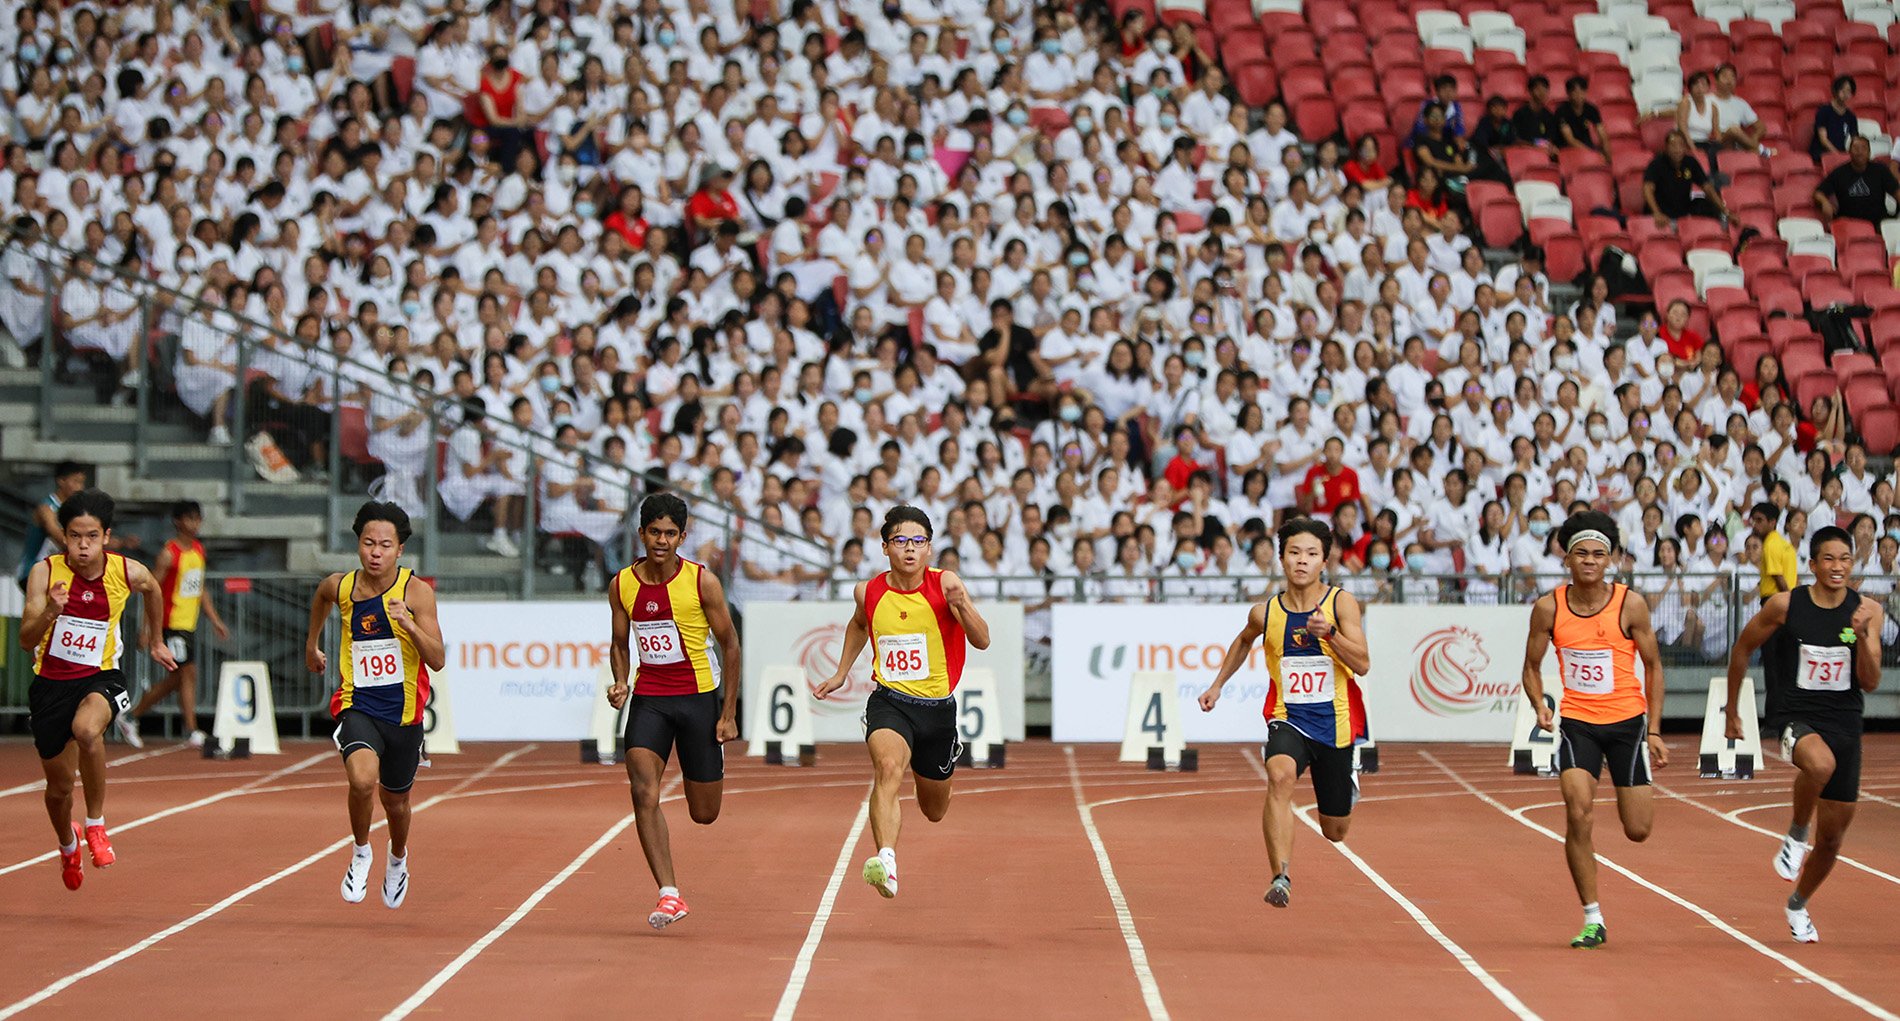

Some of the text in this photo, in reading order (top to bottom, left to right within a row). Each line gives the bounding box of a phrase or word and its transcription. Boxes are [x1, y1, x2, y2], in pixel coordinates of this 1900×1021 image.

[61, 630, 96, 652] 844
[639, 634, 673, 653] 863
[360, 653, 397, 677] 198
[885, 649, 922, 672] 485
[1570, 662, 1604, 682] 753
[1807, 660, 1844, 681] 737
[1288, 671, 1327, 694] 207
[234, 674, 257, 724] 9
[769, 683, 794, 735] 6
[960, 689, 983, 738] 5
[1142, 692, 1167, 742] 4
